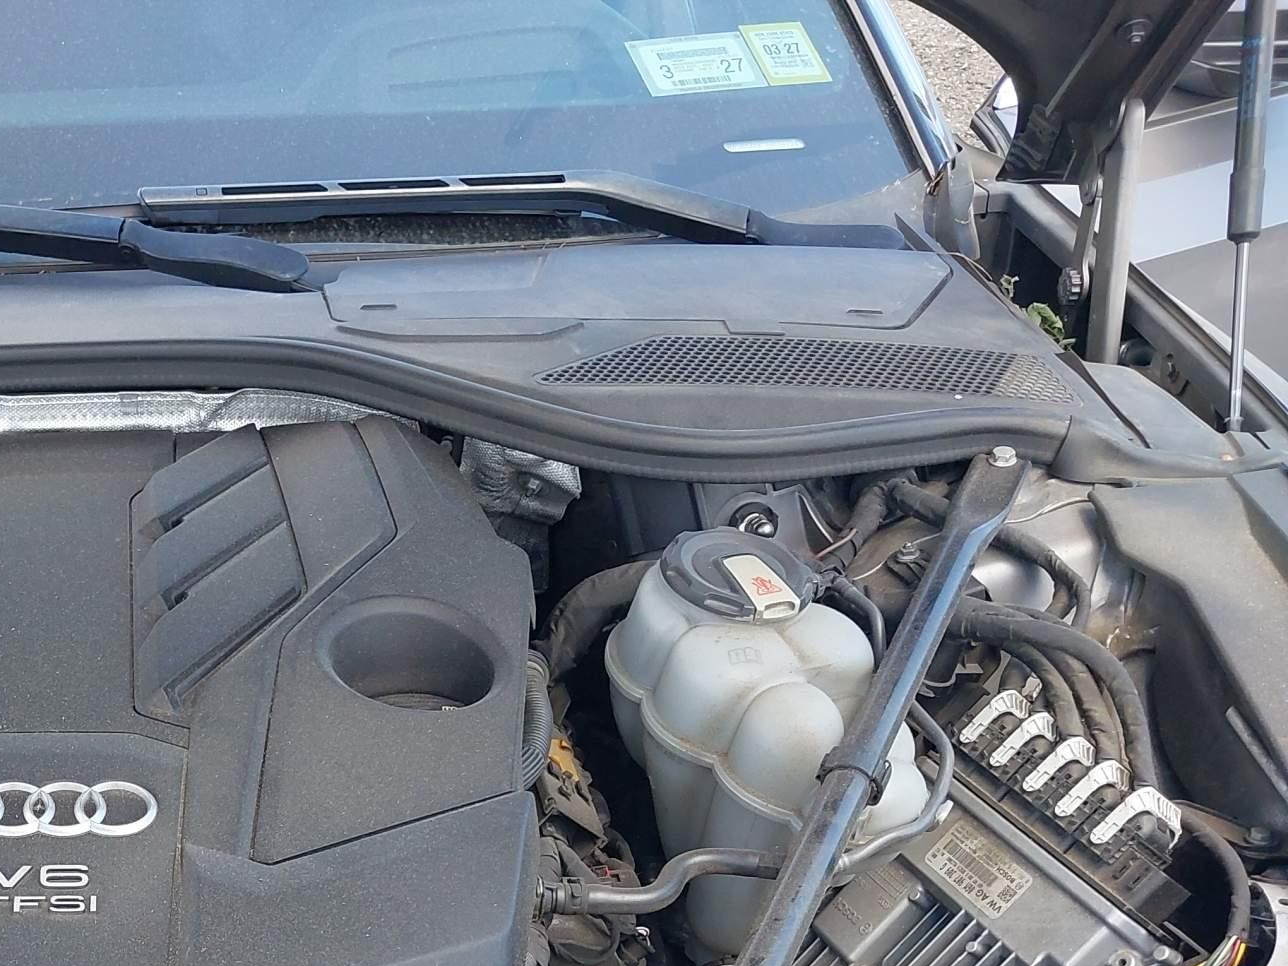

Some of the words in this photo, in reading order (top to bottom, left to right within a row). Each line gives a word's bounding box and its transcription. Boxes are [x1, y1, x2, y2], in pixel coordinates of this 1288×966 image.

[762, 44, 781, 55] 03
[783, 42, 800, 54] 27
[659, 64, 675, 79] 3
[719, 57, 744, 73] 27
